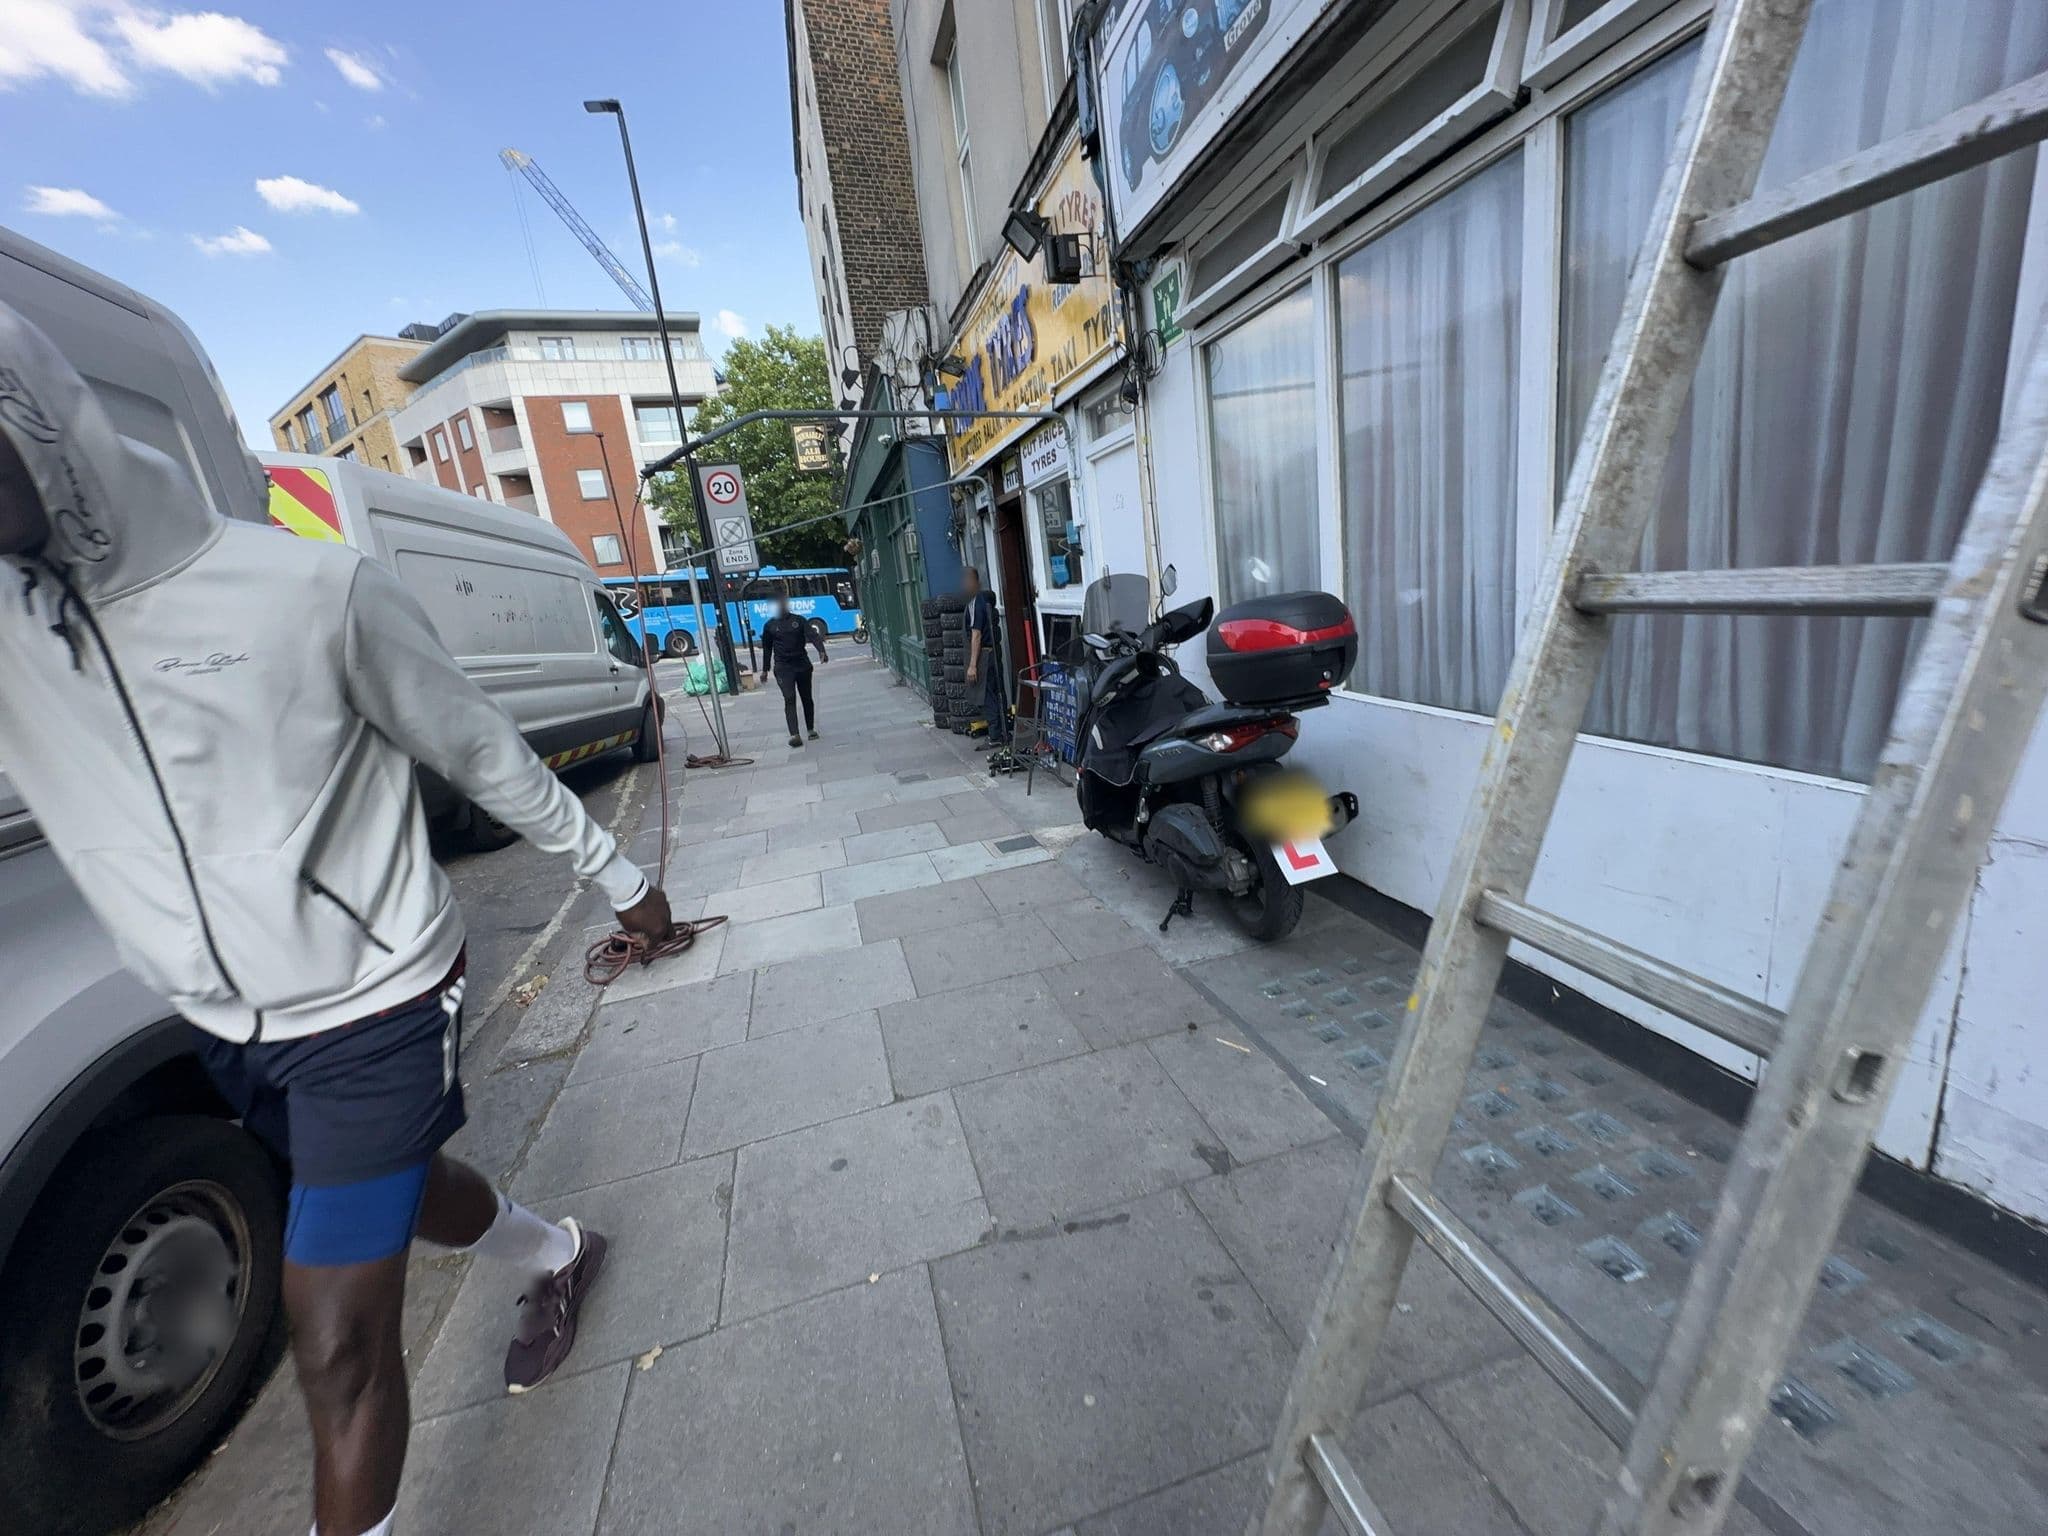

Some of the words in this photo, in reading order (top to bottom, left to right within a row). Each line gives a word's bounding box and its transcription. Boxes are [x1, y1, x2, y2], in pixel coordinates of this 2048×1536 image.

[1059, 190, 1096, 233] TYRES
[1051, 335, 1077, 384] TAXI
[1022, 440, 1038, 459] CUT
[1038, 421, 1063, 451] PRICE
[800, 455, 828, 463] HOUSE
[1031, 448, 1057, 474] TYRES
[712, 481, 735, 495] 20
[725, 554, 749, 563] ENDS
[1281, 838, 1321, 871] L
